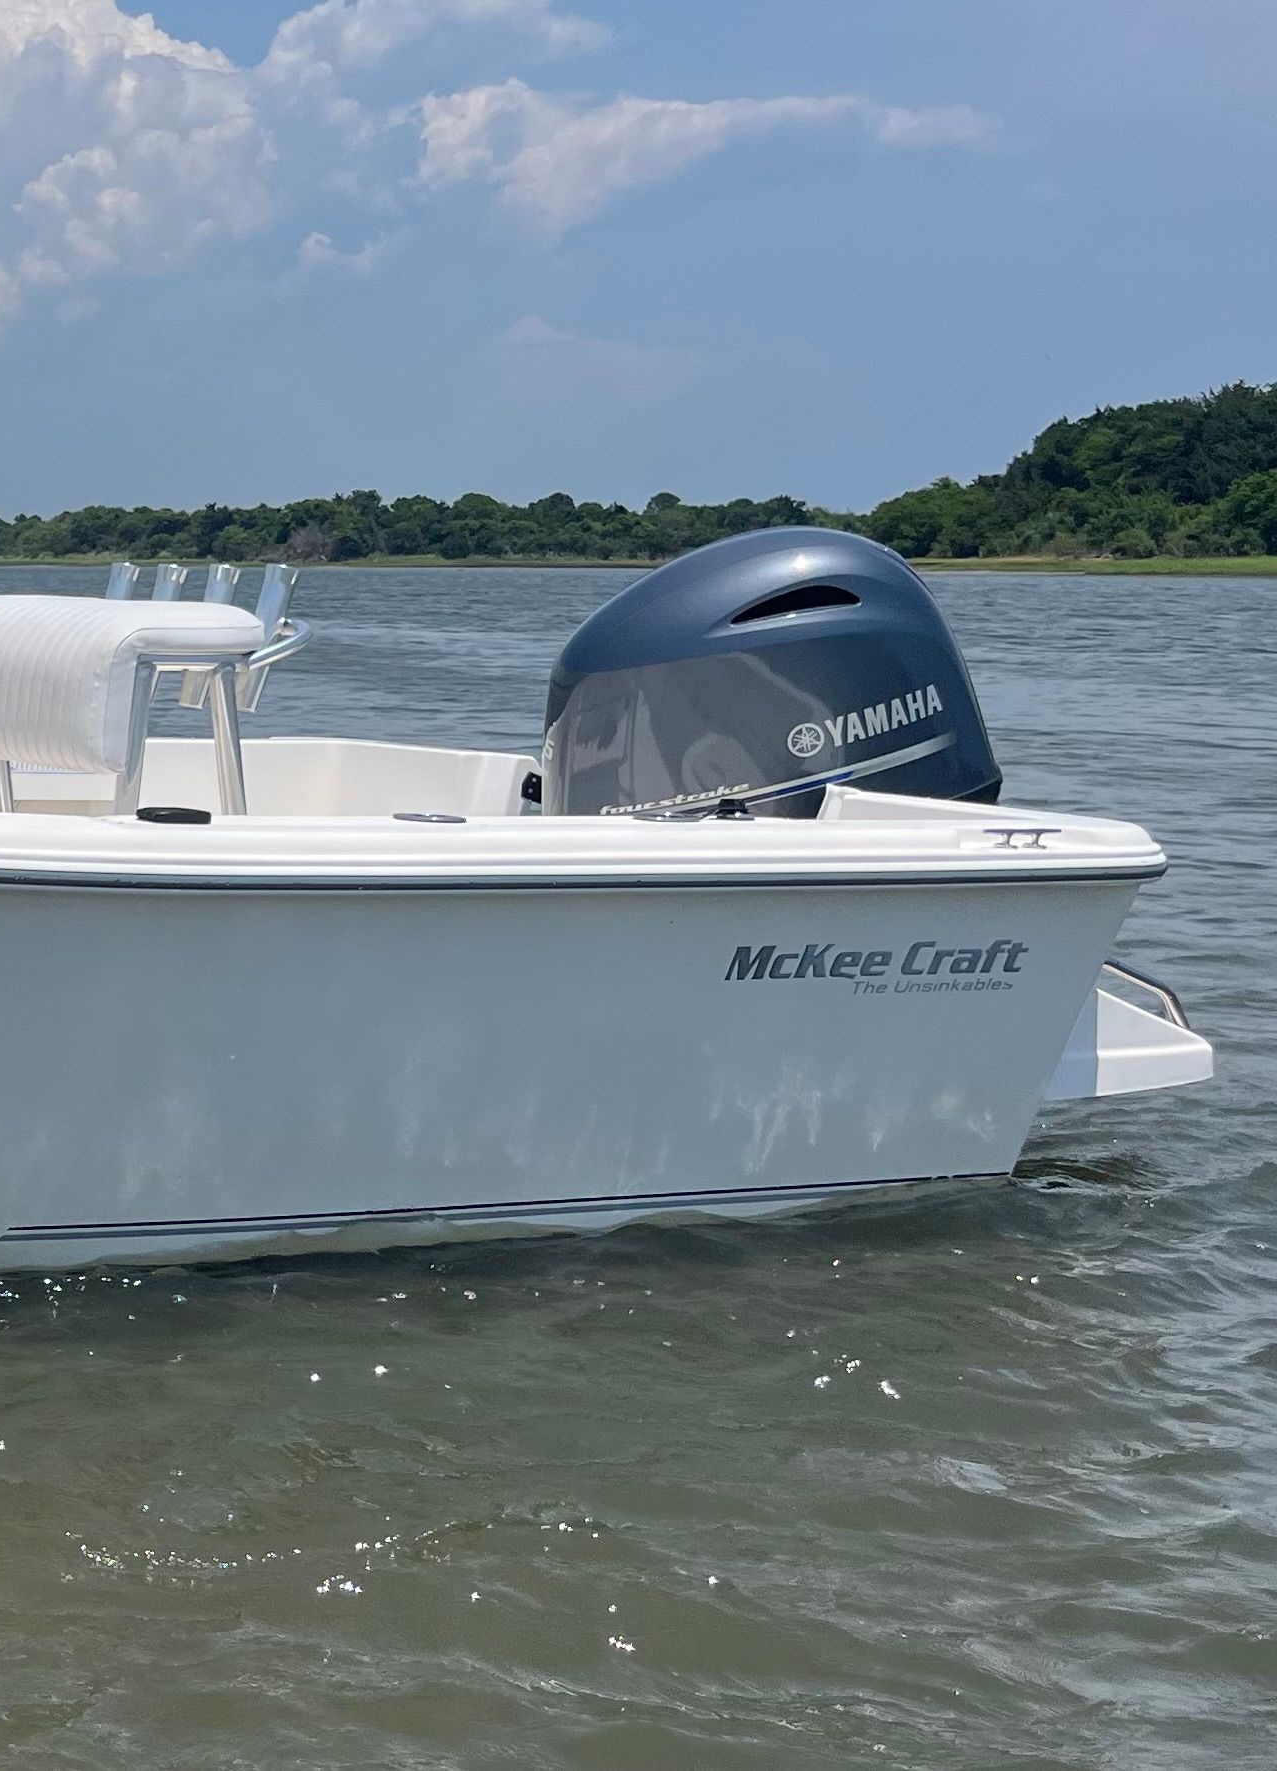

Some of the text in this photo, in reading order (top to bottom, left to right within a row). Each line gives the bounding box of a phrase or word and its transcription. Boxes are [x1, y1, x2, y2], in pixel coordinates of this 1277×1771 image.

[825, 683, 943, 747] YAMAHA
[724, 939, 1029, 981] McKee Craft
[852, 978, 1014, 995] The Unsinkables
